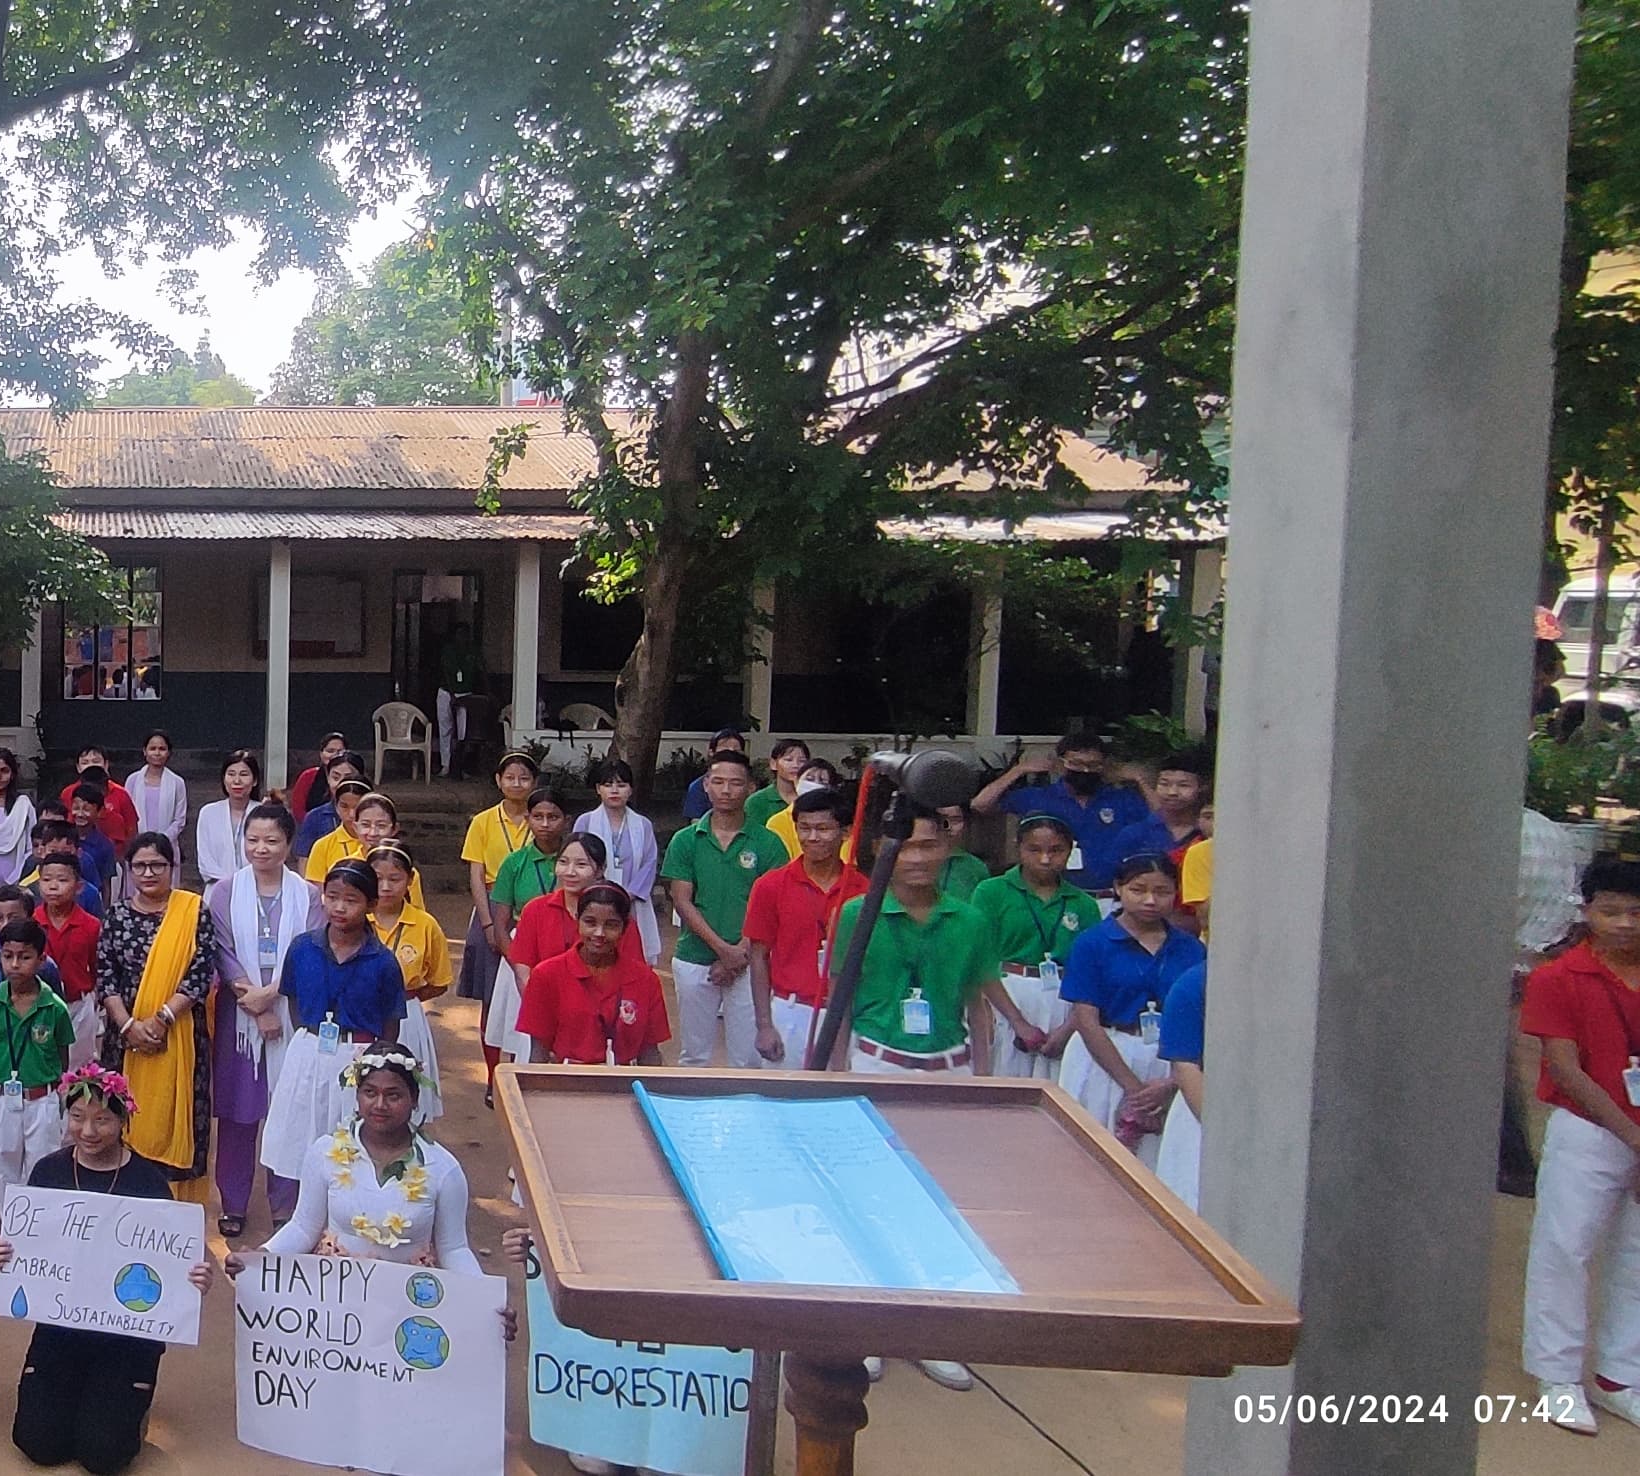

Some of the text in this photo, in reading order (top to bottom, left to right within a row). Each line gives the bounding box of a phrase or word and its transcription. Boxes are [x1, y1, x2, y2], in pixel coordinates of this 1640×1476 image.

[4, 1195, 198, 1260] BE THE CHANGE
[261, 1255, 377, 1304] HAPPY
[236, 1303, 361, 1346] WORLD
[252, 1341, 416, 1383] ENVIRONMENT
[254, 1370, 317, 1409] DAY
[534, 1353, 751, 1418] DEFORESTATIO
